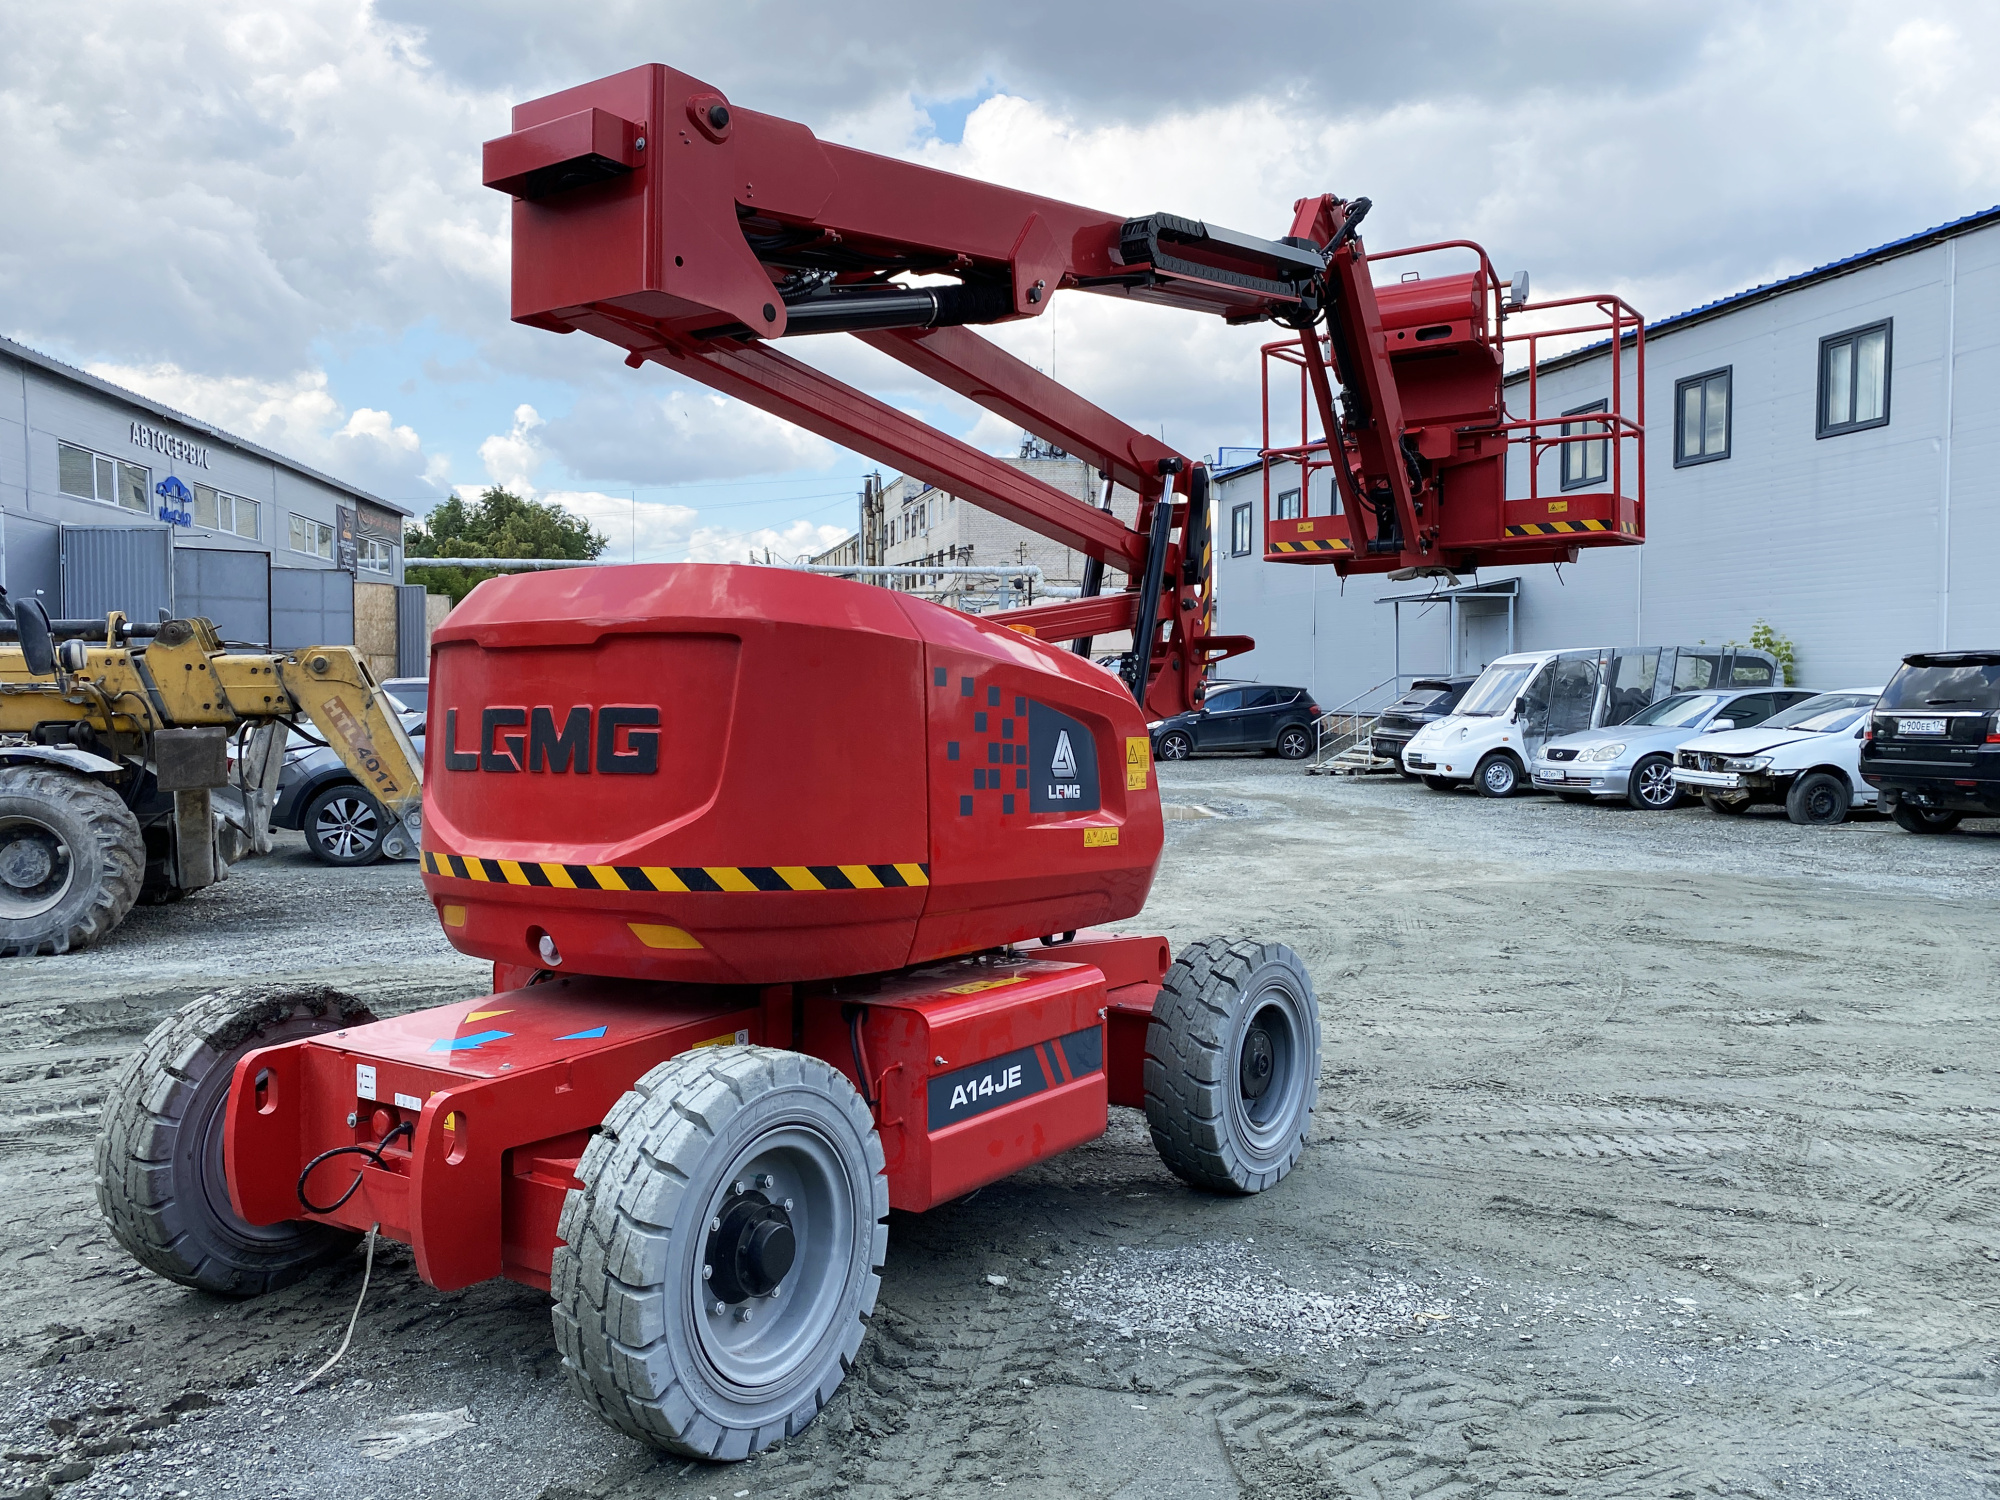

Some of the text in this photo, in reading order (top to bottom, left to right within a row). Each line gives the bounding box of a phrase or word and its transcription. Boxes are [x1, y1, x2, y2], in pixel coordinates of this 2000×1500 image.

[131, 421, 211, 470] АВТОСЕРВИС
[445, 704, 661, 774] LGMG
[357, 746, 398, 793] 4017
[1048, 784, 1081, 799] LGMG
[949, 1064, 1022, 1110] A14JE
